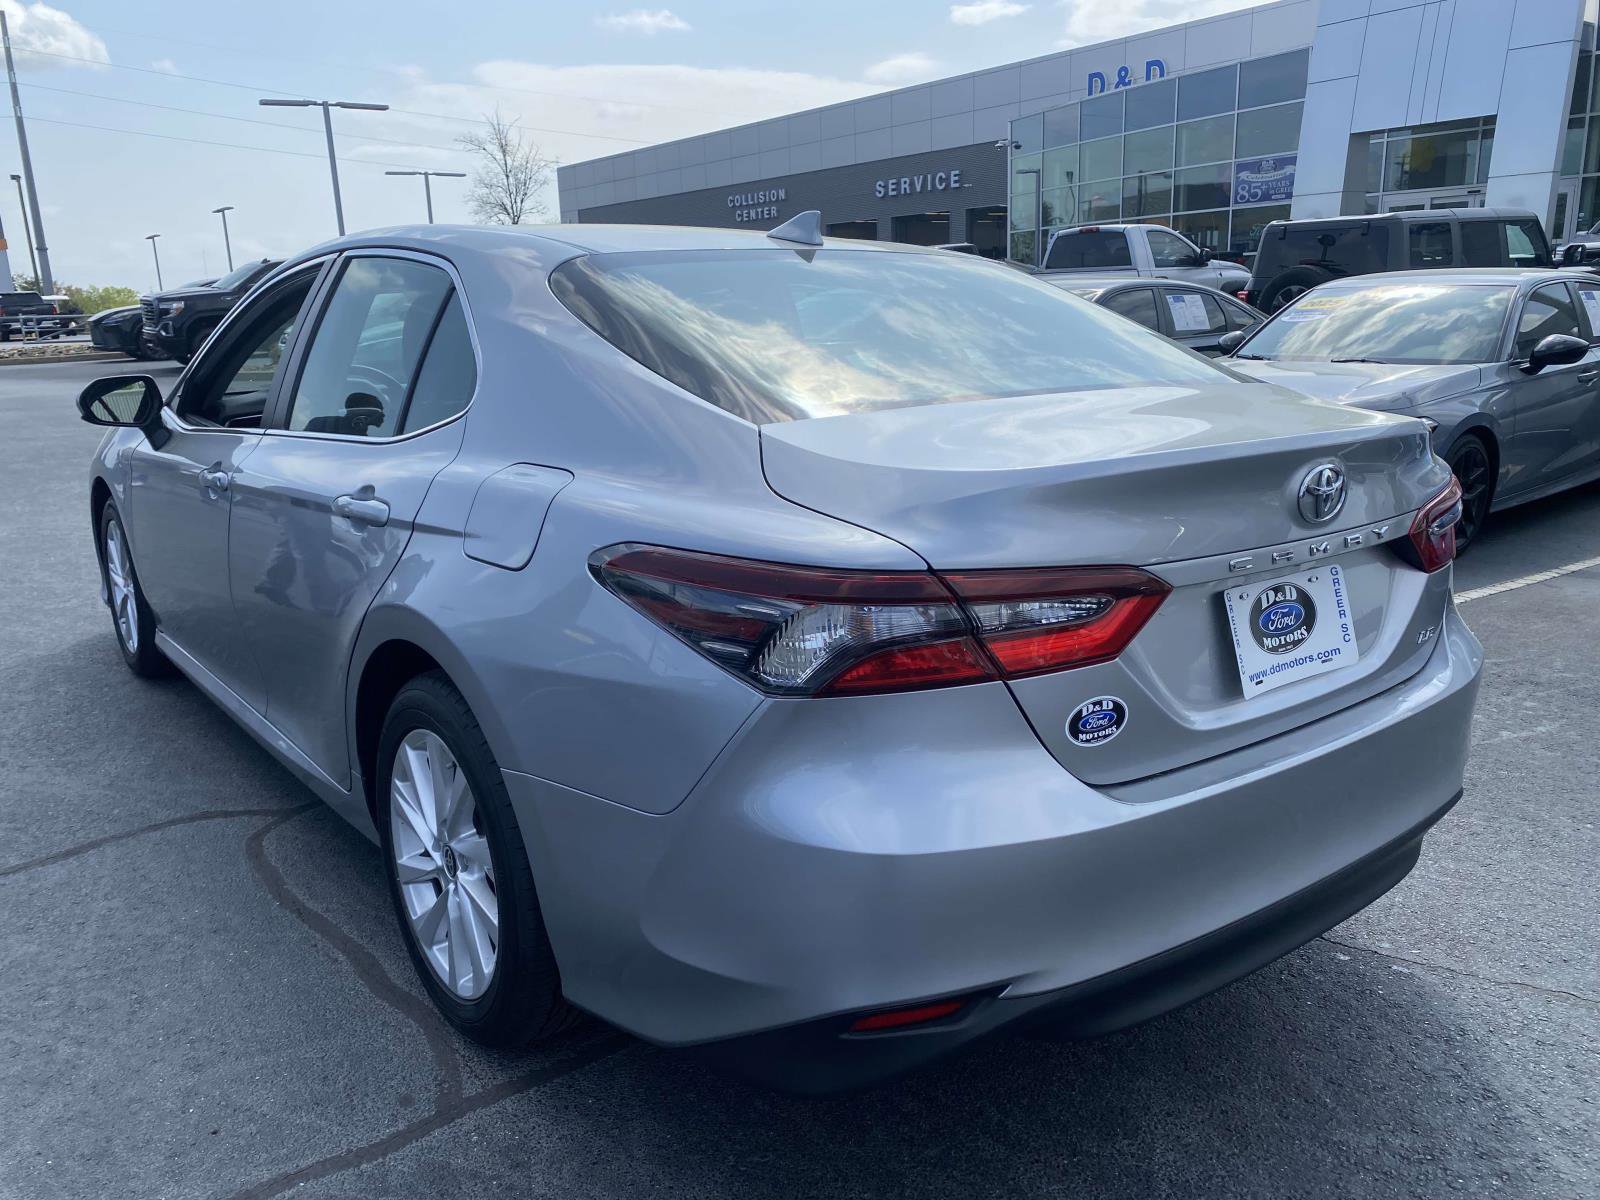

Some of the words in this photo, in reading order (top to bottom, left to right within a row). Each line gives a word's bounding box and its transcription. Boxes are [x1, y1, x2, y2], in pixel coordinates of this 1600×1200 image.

[875, 170, 961, 198] SERVICE
[727, 188, 786, 208] COLLISION
[735, 206, 778, 222] CENTER
[1229, 526, 1389, 573] CAMRY
[1260, 586, 1298, 610] D&D
[1330, 567, 1347, 619] GREER
[1341, 623, 1351, 643] SC
[1268, 608, 1297, 631] Ford
[1262, 626, 1309, 650] MOTORS
[1248, 646, 1341, 683] www.ddmotors.com
[1081, 700, 1114, 717] D&D
[1086, 714, 1110, 729] Ford
[1078, 725, 1117, 742] MOTORS
